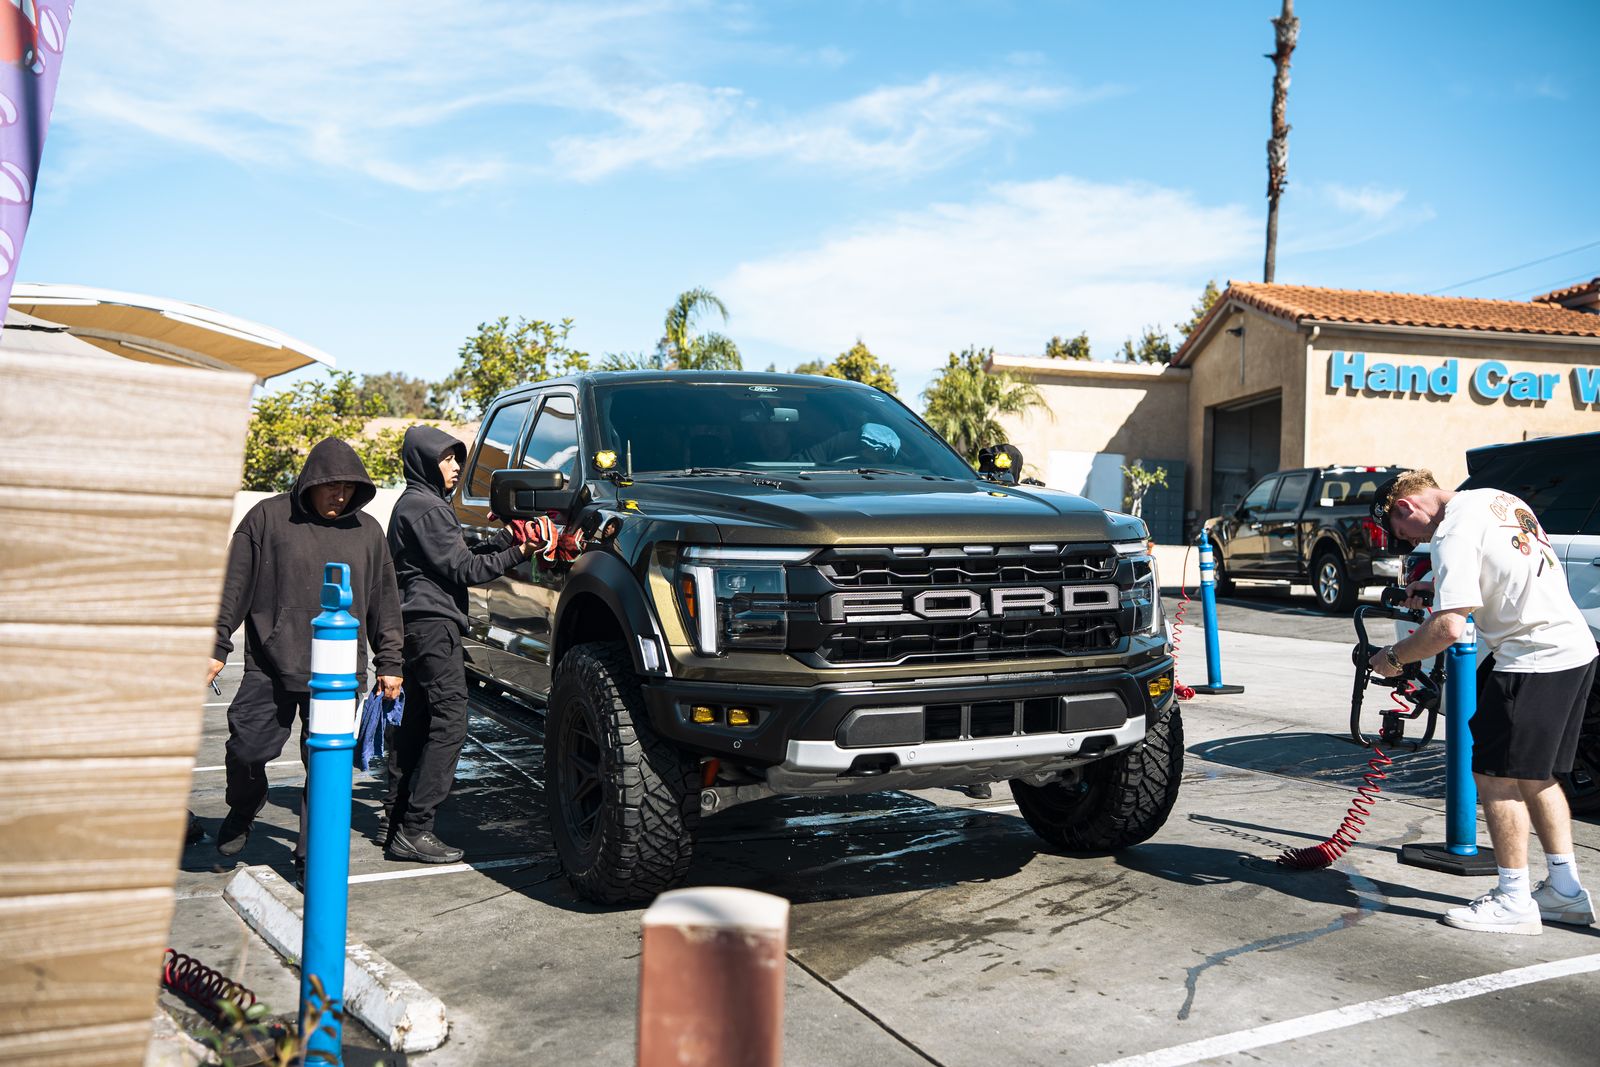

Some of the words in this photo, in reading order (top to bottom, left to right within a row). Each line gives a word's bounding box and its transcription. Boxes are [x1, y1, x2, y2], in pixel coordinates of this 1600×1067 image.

[1331, 351, 1458, 395] Hand
[1474, 359, 1560, 400] Car
[830, 584, 1120, 622] FORD
